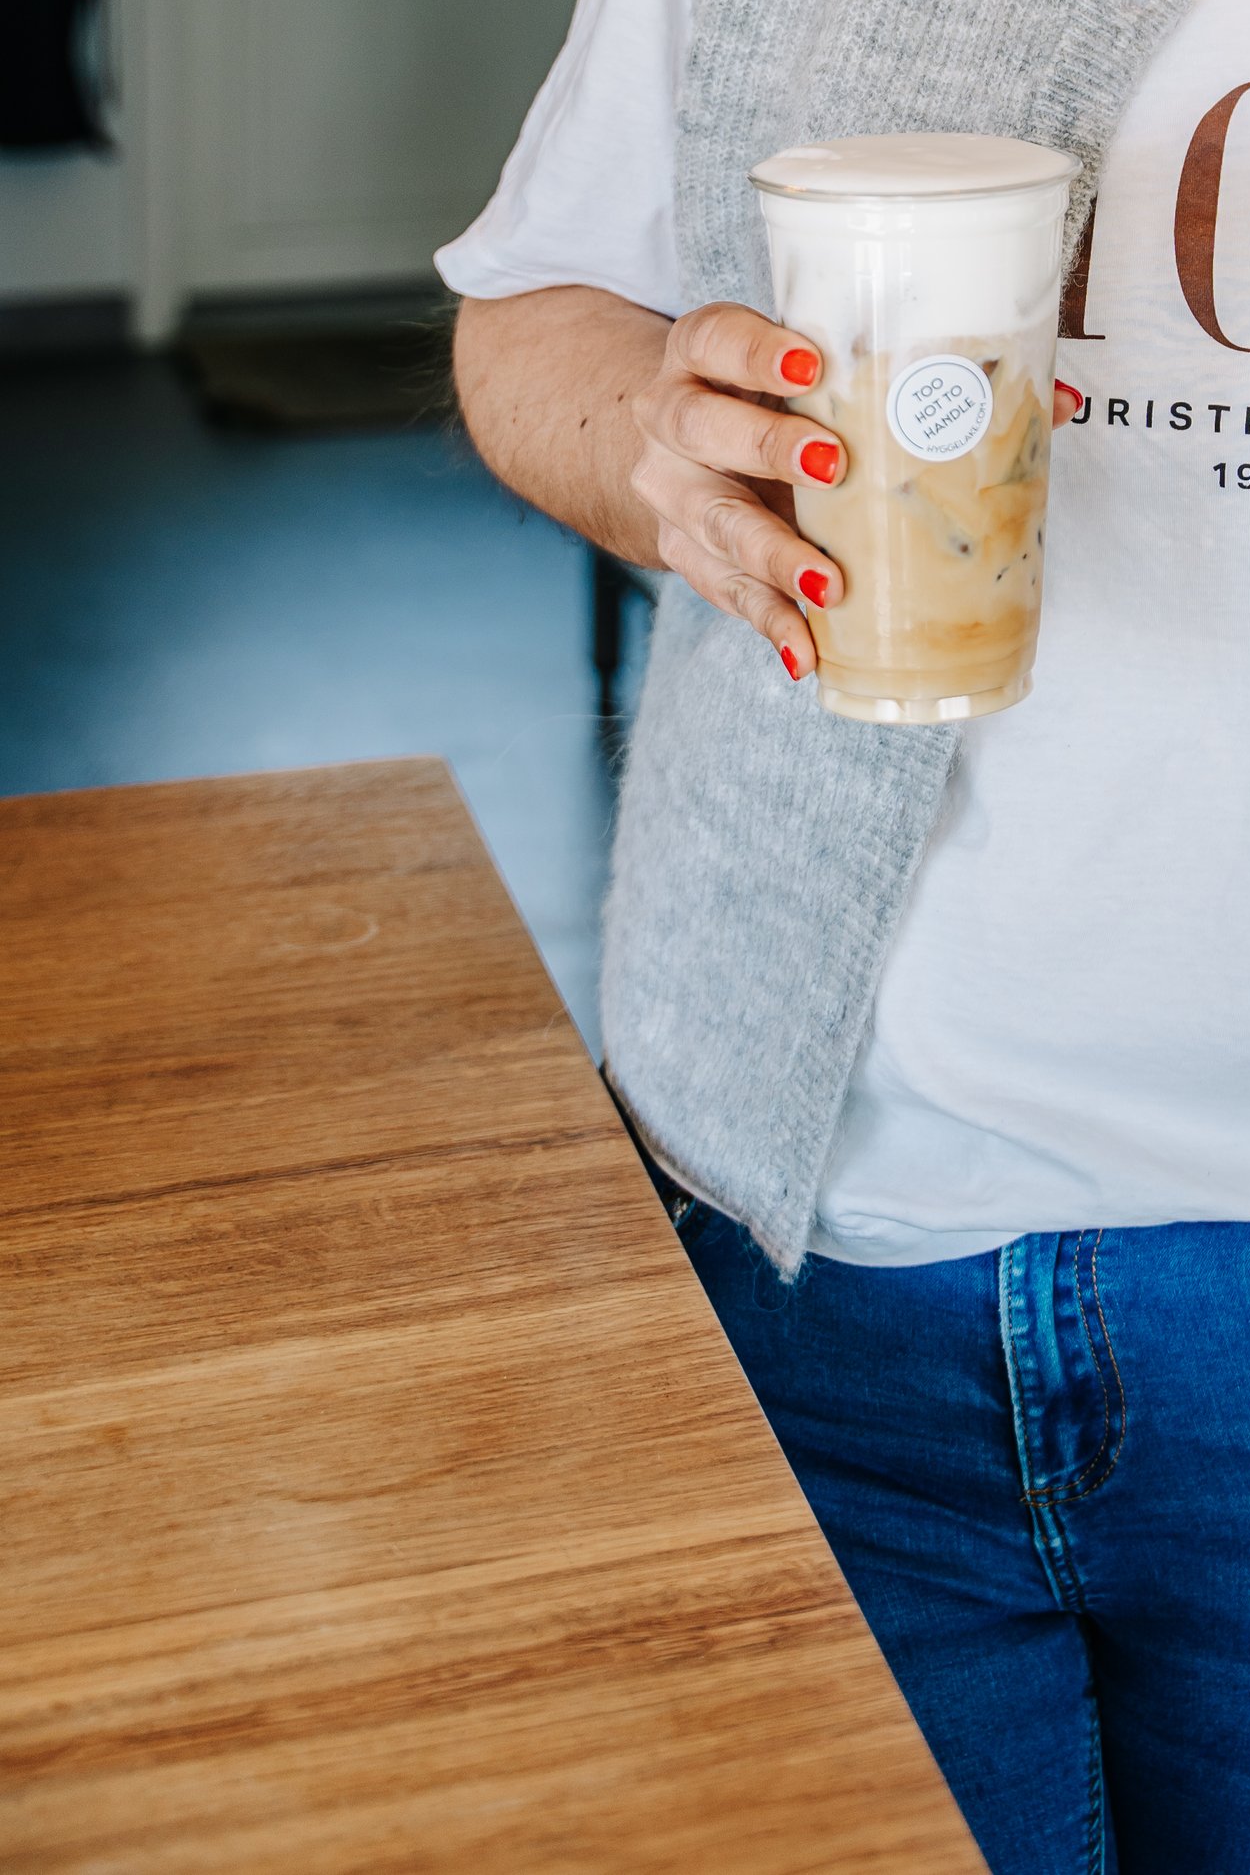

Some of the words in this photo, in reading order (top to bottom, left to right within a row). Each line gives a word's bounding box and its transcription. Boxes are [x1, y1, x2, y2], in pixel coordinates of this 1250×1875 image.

[912, 377, 944, 402] TOO
[914, 400, 944, 424] HOT
[942, 384, 963, 403] TO
[923, 396, 976, 439] HANDLE
